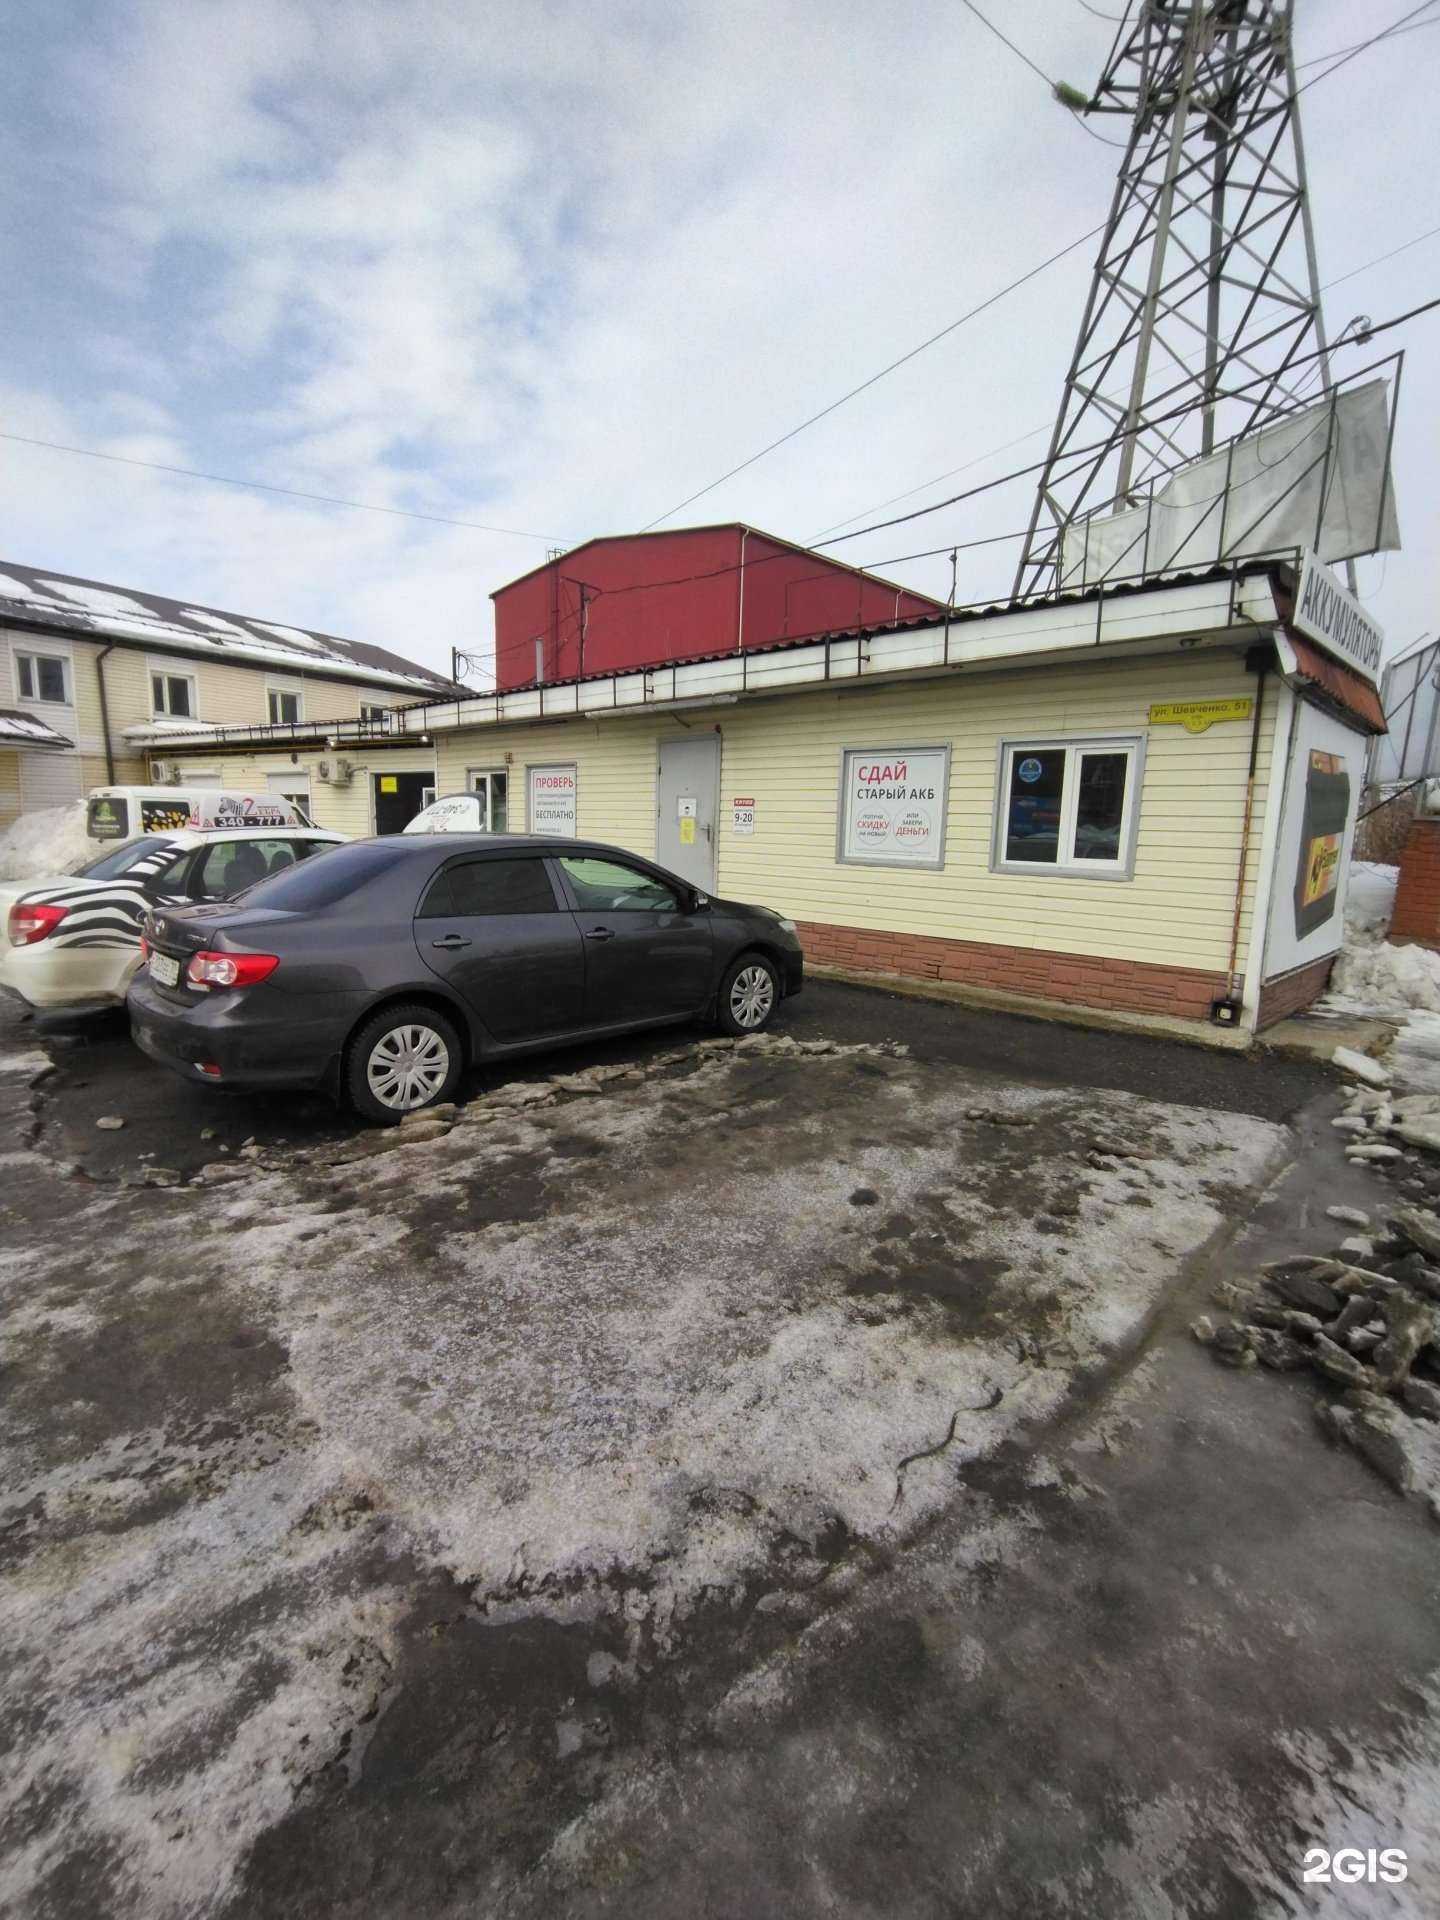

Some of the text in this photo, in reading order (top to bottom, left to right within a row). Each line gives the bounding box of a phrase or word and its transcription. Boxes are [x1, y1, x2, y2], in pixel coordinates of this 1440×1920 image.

[1301, 566, 1382, 671] АККУМУЛЯТОРЫ
[1235, 701, 1247, 711] 51
[858, 760, 907, 785] СДАЙ
[536, 776, 574, 788] ПРОВЕРЬ
[857, 785, 935, 800] СТАРЫЙ АКБ
[536, 810, 574, 820] БЕСПЛАТНО
[857, 820, 889, 830] СКИДКУ
[896, 827, 929, 837] ДЕНЬГИ
